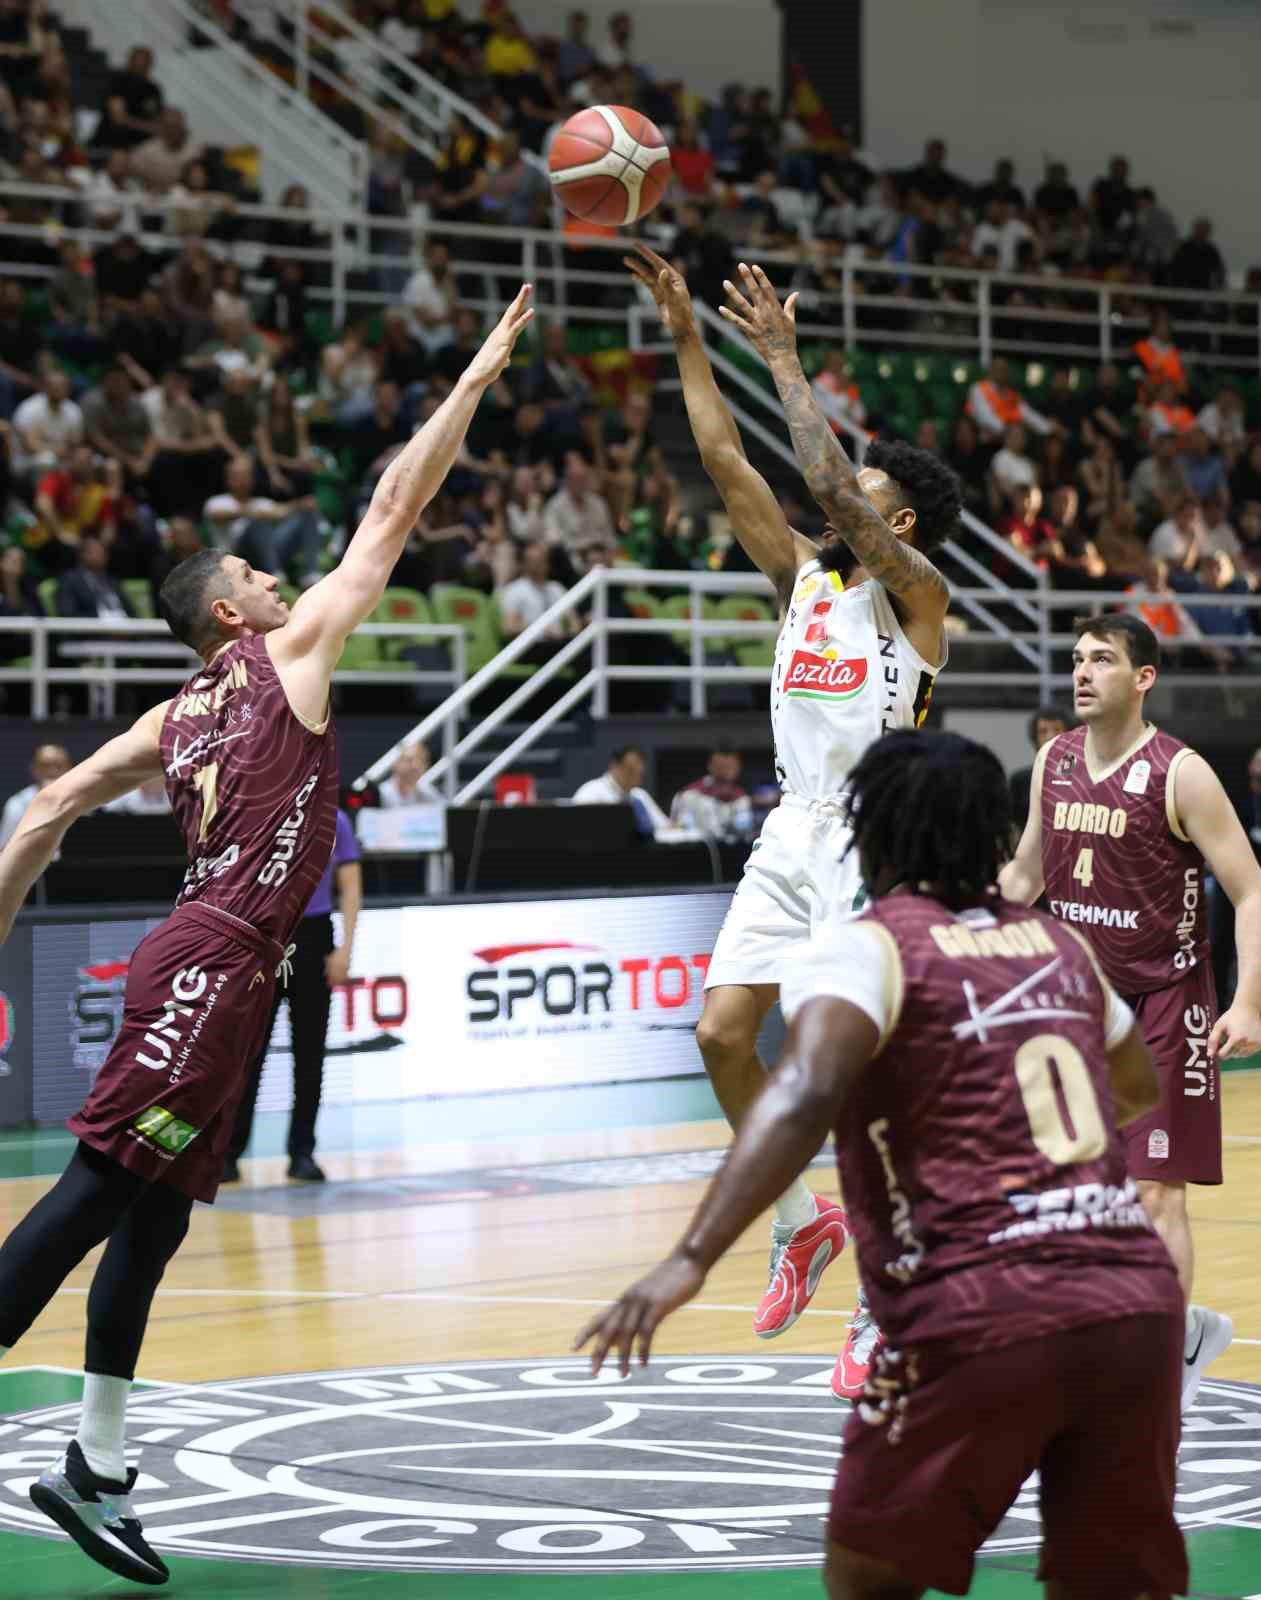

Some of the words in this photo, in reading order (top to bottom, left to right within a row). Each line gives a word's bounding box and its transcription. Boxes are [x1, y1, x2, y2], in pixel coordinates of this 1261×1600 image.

[1053, 801, 1128, 838] BORDO
[1073, 848, 1094, 887] 4
[135, 966, 208, 1071] UMG
[1184, 1004, 1208, 1097] UMG
[1014, 1033, 1108, 1165] 0
[319, 1518, 796, 1554] COF
